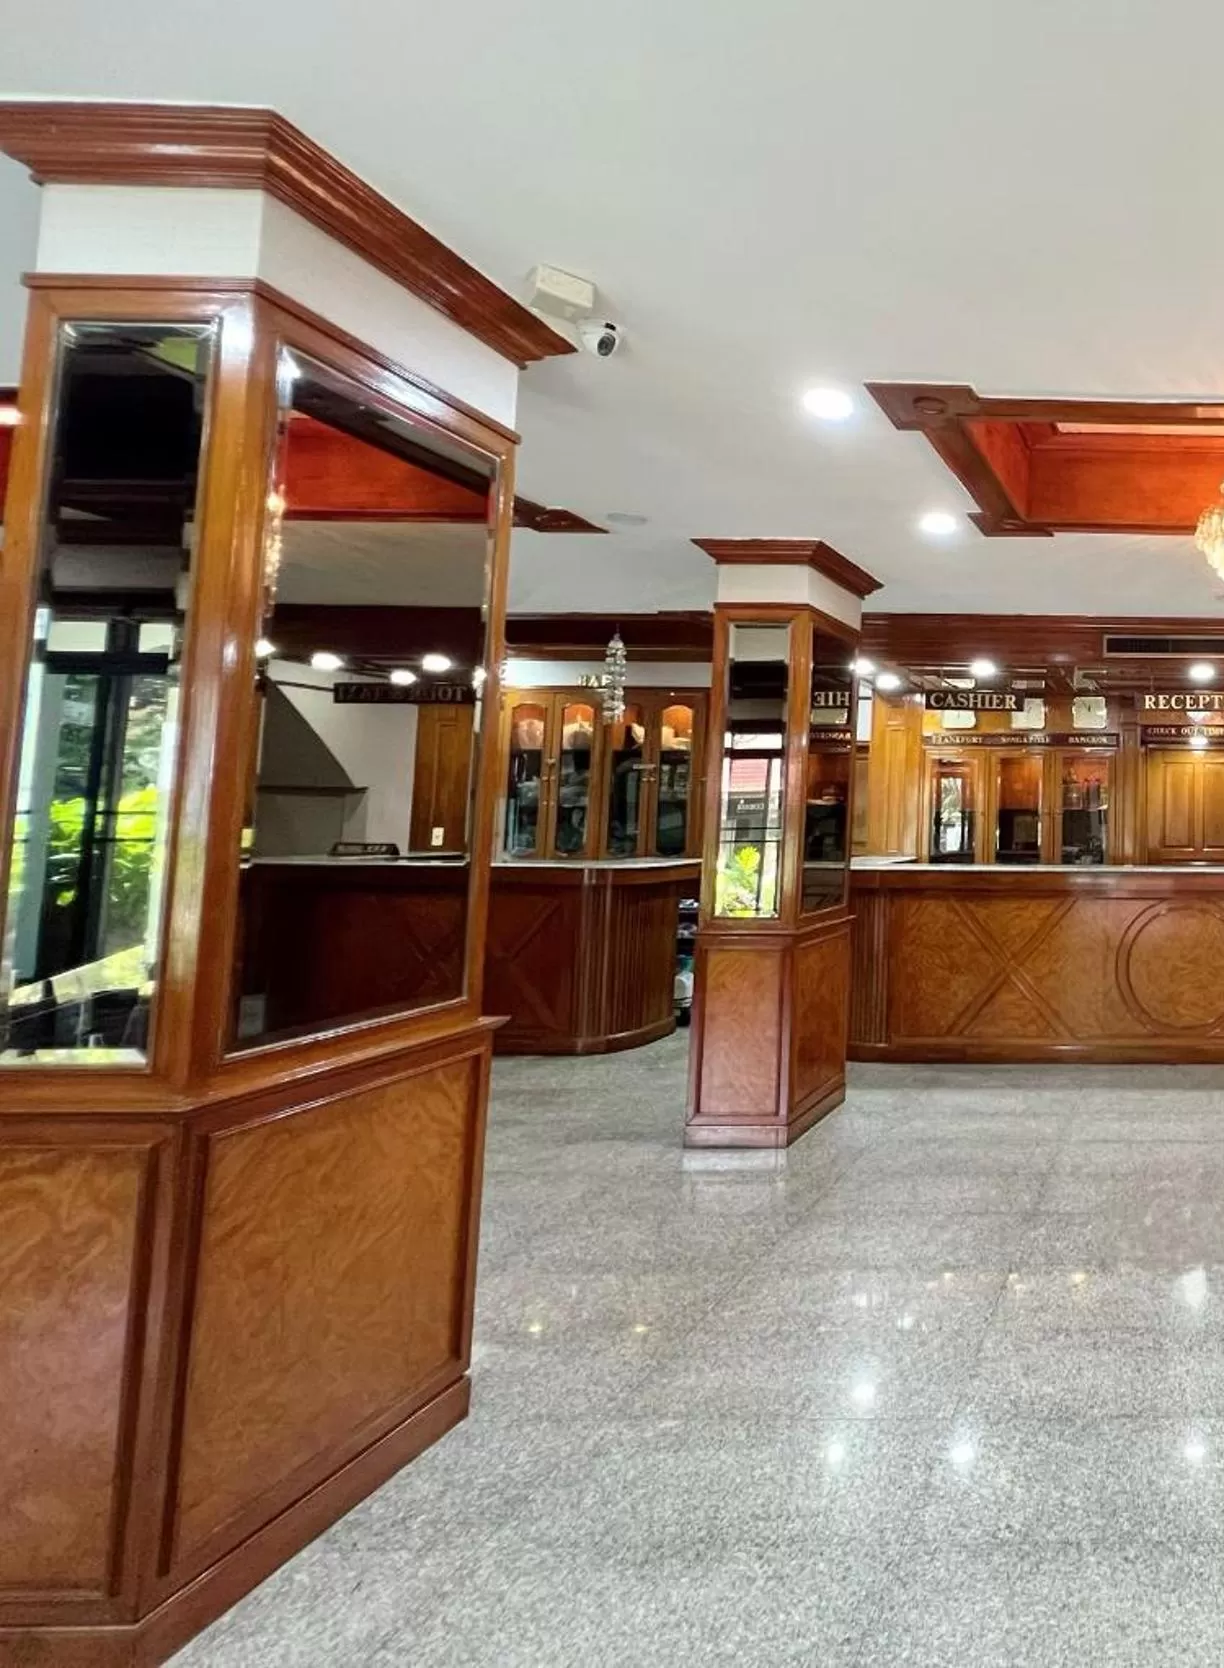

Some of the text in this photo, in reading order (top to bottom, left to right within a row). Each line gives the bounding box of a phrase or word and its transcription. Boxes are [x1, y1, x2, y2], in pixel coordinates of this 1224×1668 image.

[930, 692, 1017, 709] CASHIER
[1147, 727, 1177, 736] CHECK
[1181, 726, 1199, 736] OUT
[1203, 726, 1224, 736] TIME
[1068, 735, 1109, 745] BANGKOK
